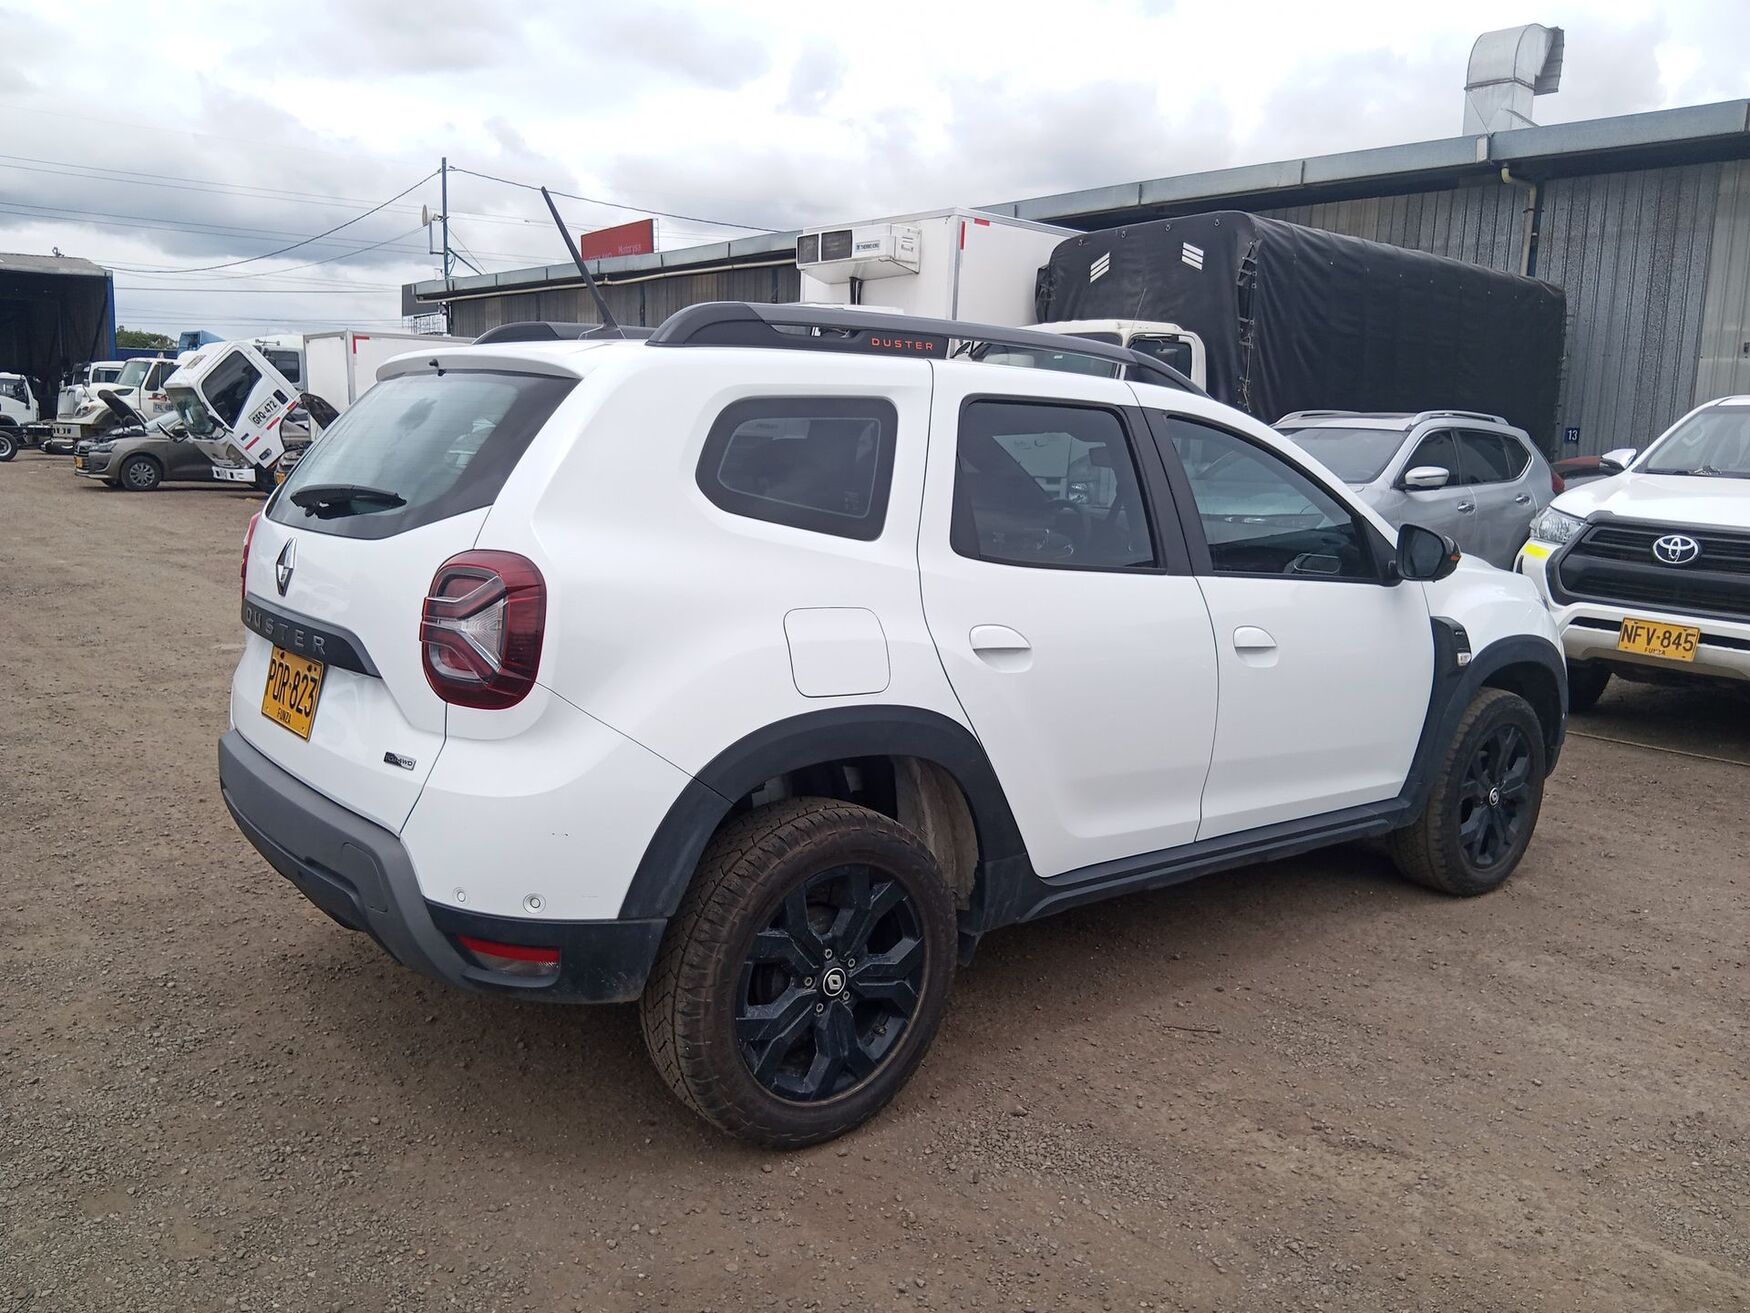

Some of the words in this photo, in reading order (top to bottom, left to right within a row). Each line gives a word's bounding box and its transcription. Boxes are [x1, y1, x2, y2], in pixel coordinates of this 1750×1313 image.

[871, 337, 935, 351] DUSTER
[1567, 429, 1578, 441] 13
[245, 606, 326, 656] DUSTER
